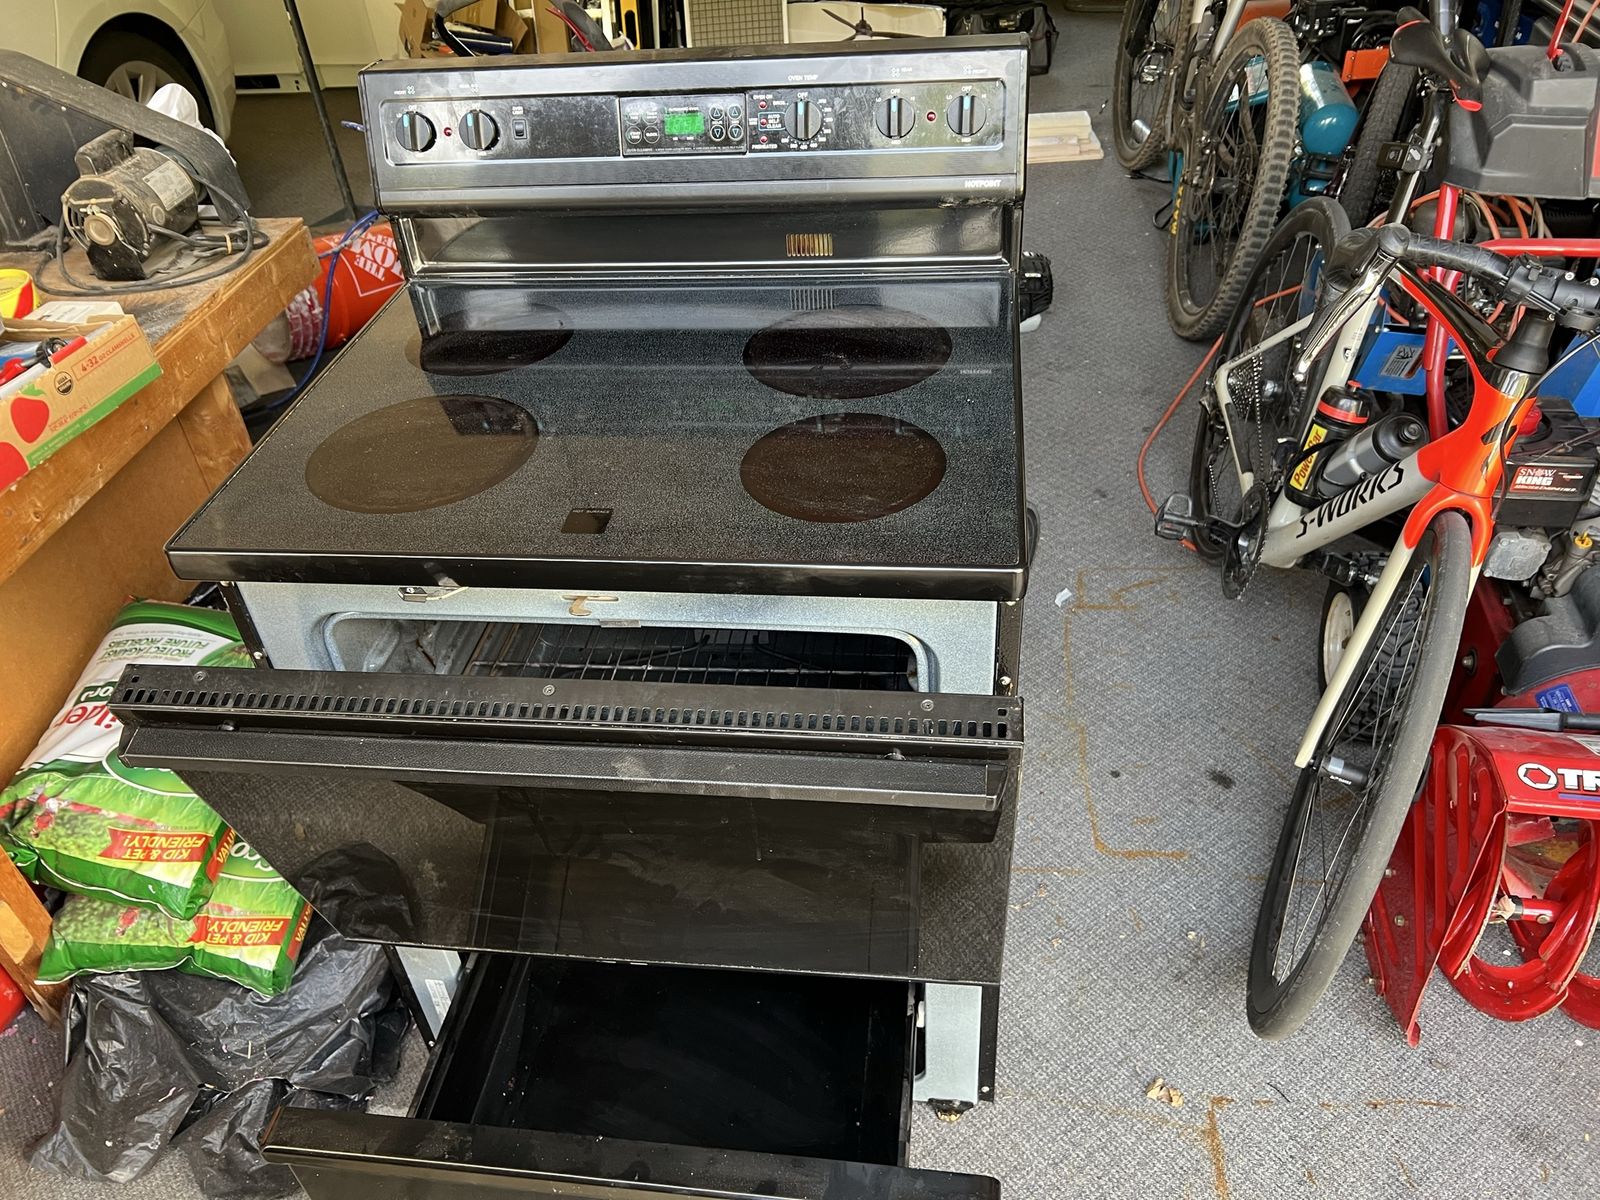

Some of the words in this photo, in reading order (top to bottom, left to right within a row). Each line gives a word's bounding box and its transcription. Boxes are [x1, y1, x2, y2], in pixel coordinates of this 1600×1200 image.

[964, 179, 1001, 188] HOTPOINT
[354, 254, 385, 282] THE
[1519, 468, 1557, 477] SNOW
[1515, 476, 1553, 486] KING
[1295, 460, 1404, 539] S-WORKS
[163, 638, 210, 650] FUTURE
[146, 645, 196, 659] PROTECT
[53, 704, 117, 729] ilder
[123, 835, 205, 849] FRIENDLY!
[122, 848, 145, 860] PET
[150, 848, 159, 861] &
[164, 848, 191, 861] KID
[207, 919, 284, 932] FRIENDLY!
[206, 931, 229, 944] PET
[231, 932, 240, 945] &
[244, 932, 271, 944] KID
